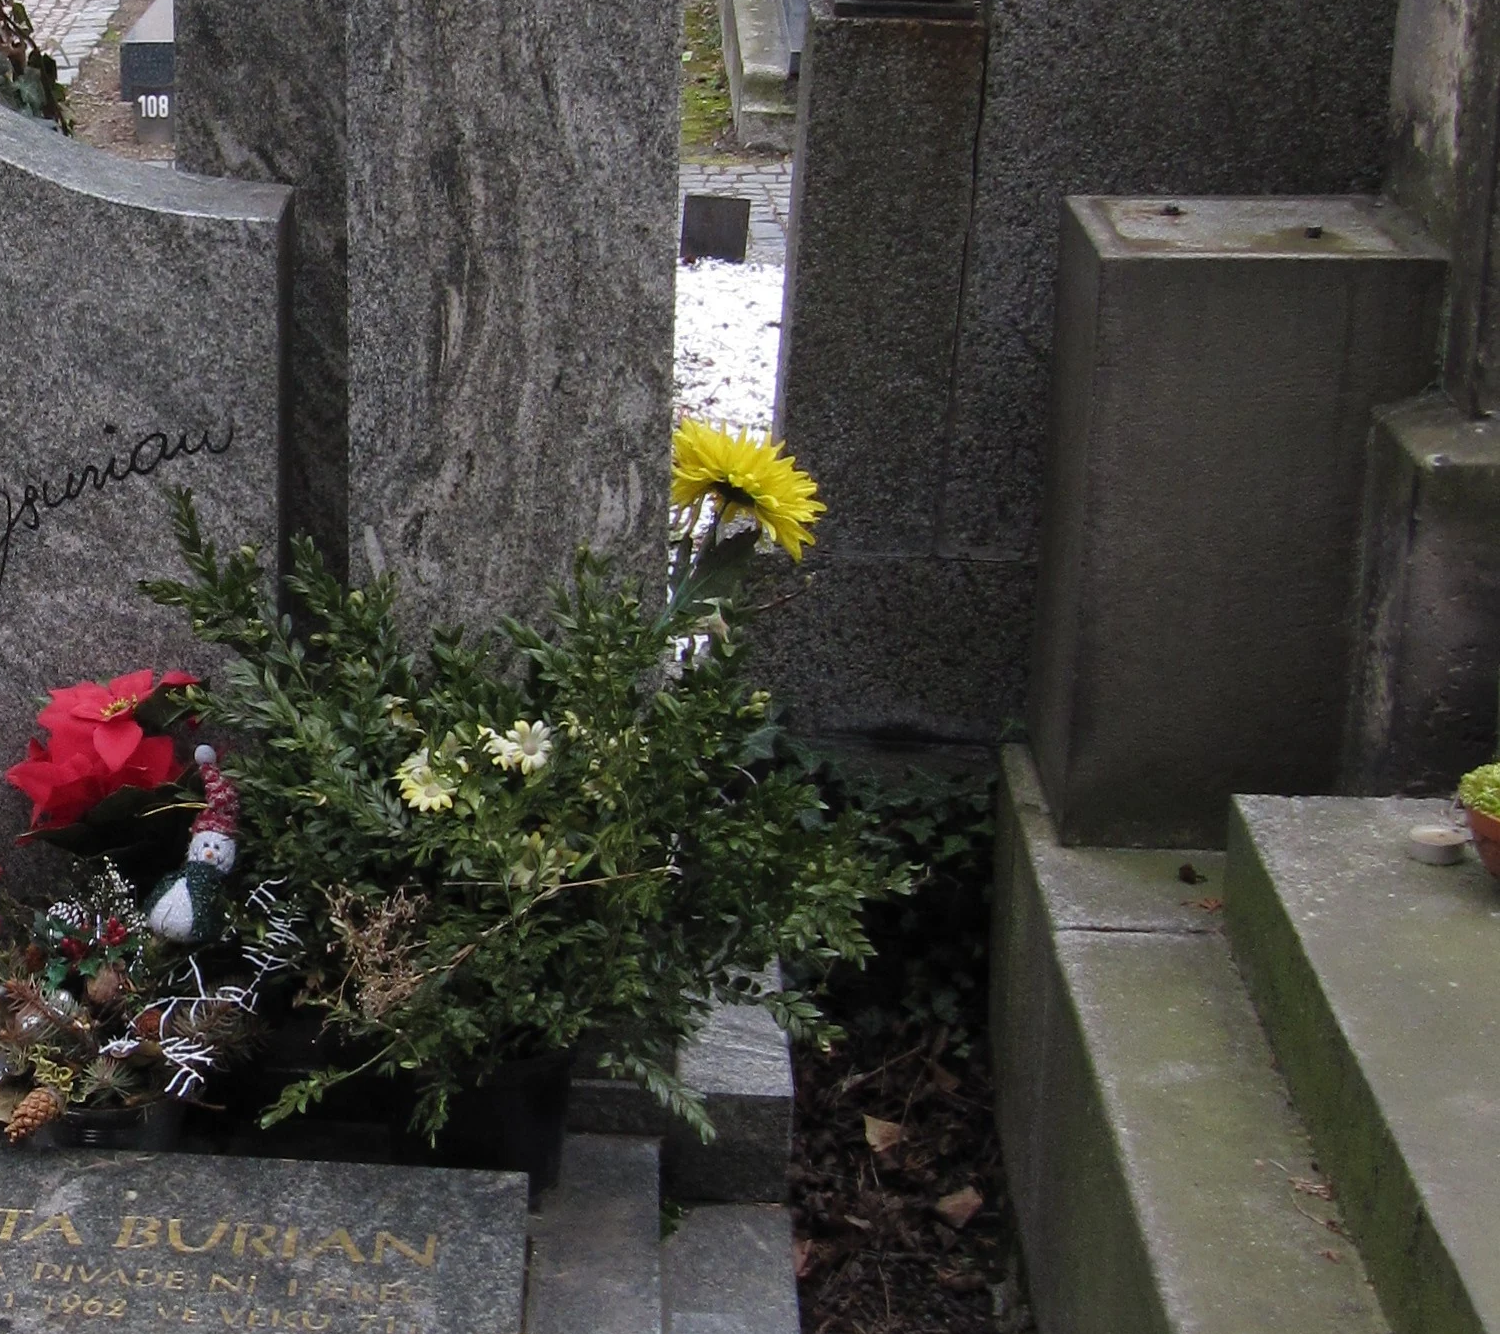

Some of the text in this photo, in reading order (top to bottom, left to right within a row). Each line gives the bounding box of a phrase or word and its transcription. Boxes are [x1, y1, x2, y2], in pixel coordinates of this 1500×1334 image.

[137, 94, 170, 118] 108
[111, 1216, 439, 1268] BURIAN
[33, 1261, 258, 1296] DIVADENÍ
[45, 1293, 128, 1319] 1962
[157, 1301, 198, 1324] VE
